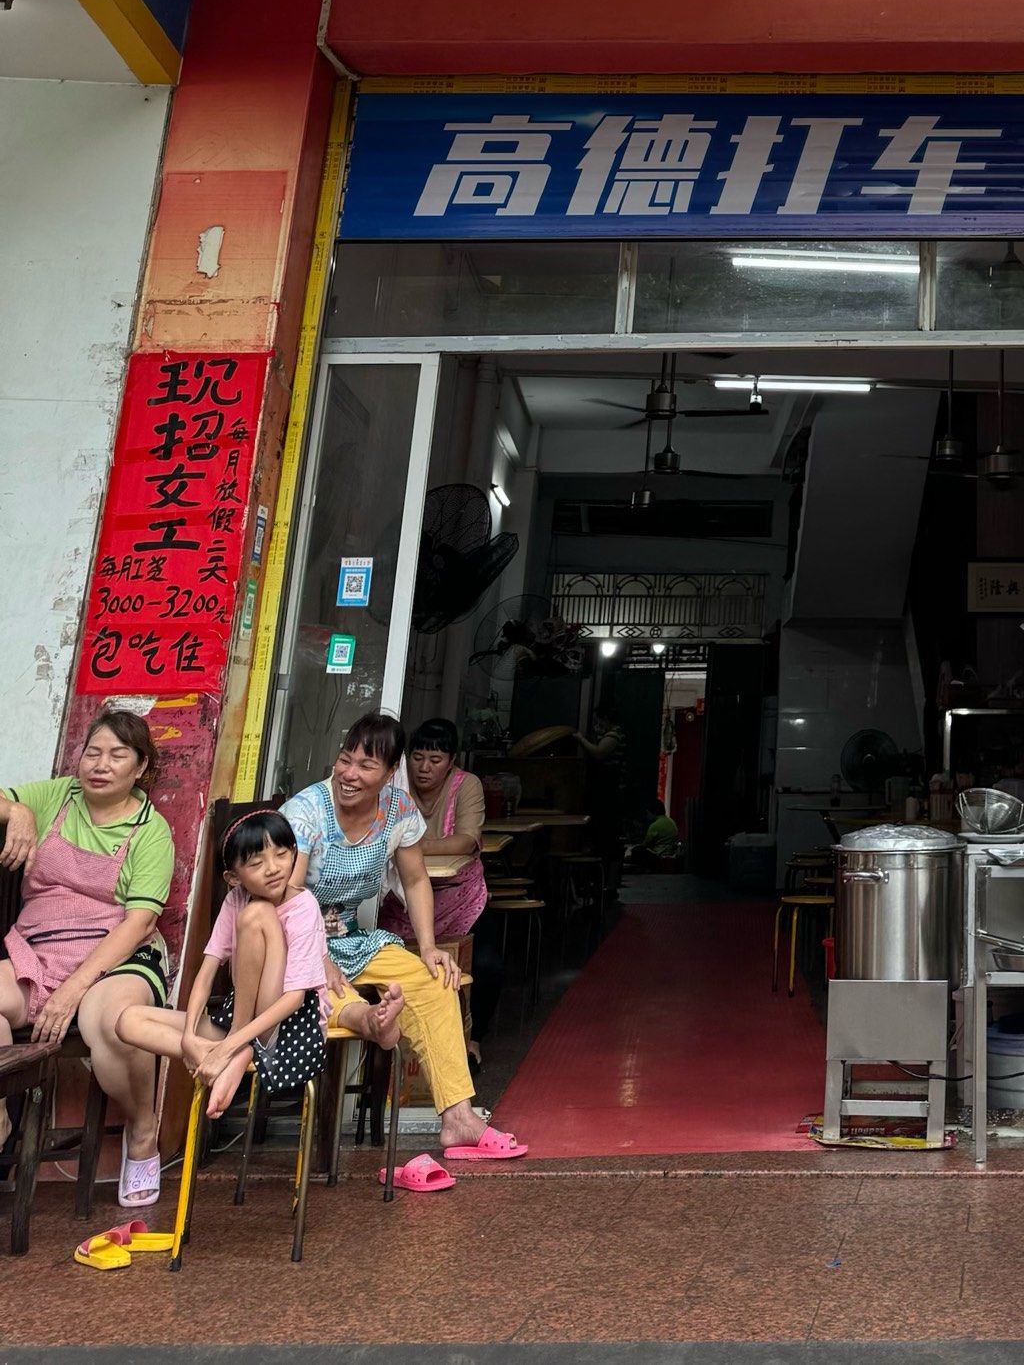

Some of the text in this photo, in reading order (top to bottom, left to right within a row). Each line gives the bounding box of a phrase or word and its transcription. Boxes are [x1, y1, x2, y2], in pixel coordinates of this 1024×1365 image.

[413, 115, 1003, 219] 高德打车
[134, 357, 243, 553] 现招女工
[197, 419, 250, 584] 每月放假二天
[91, 625, 205, 679] 包吃住
